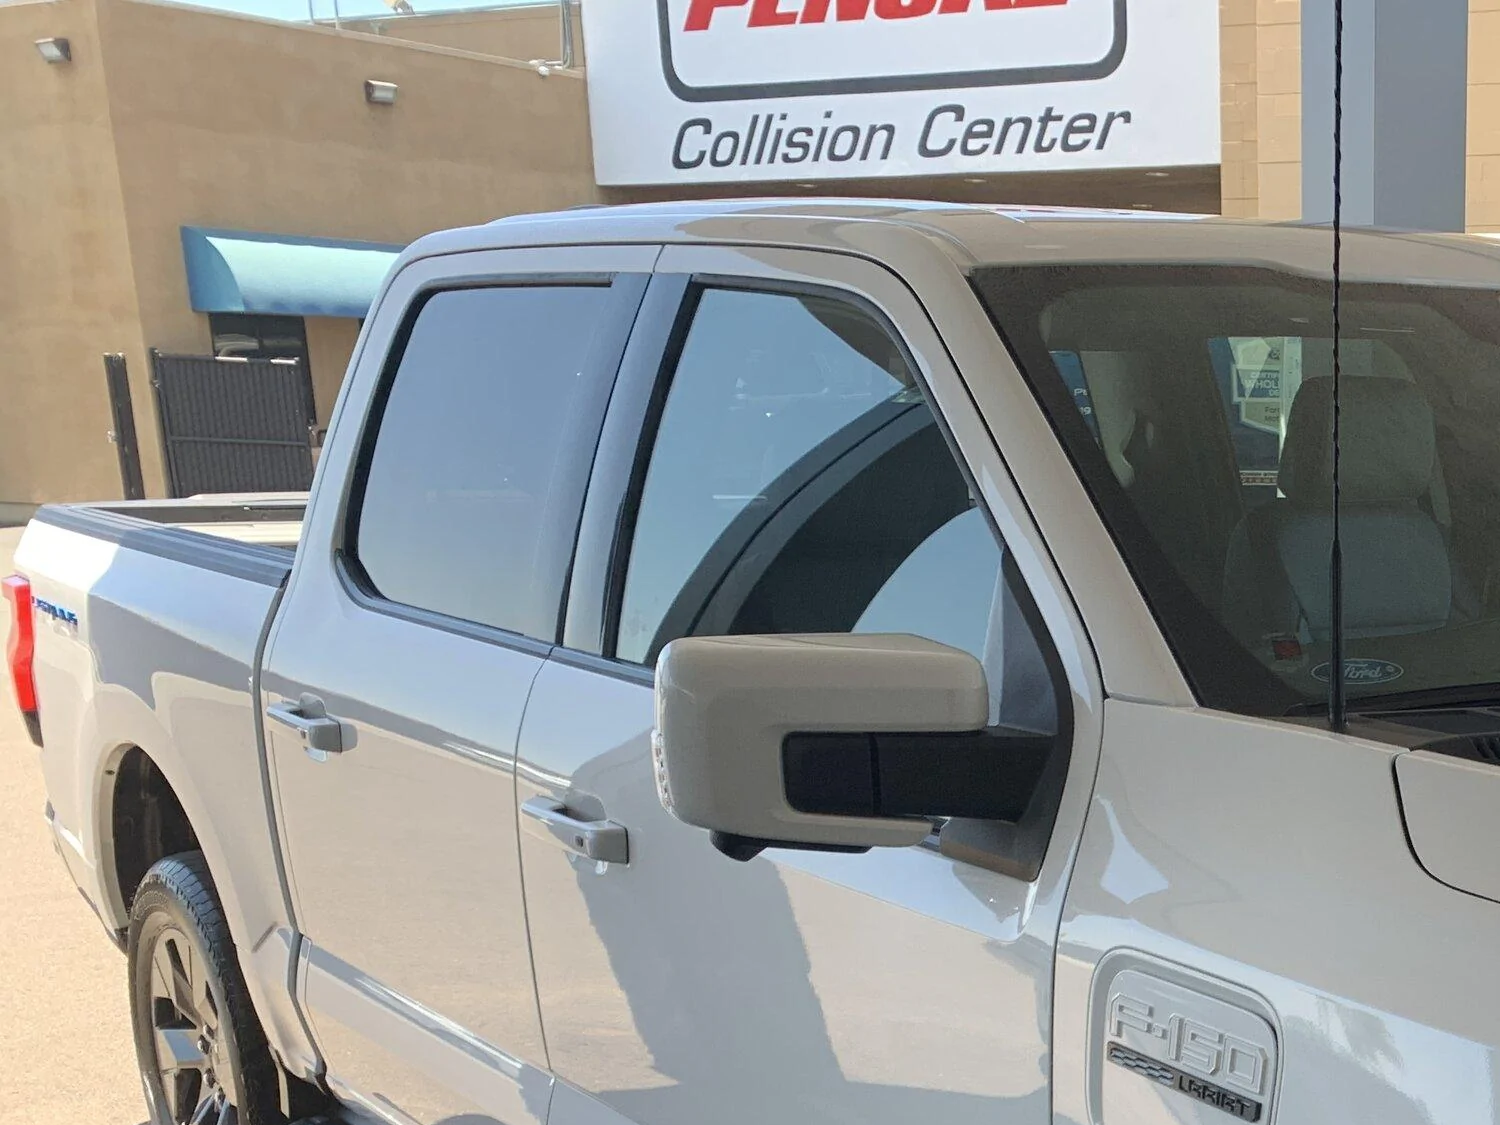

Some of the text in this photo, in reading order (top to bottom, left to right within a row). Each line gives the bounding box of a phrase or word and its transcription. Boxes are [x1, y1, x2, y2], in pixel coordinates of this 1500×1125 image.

[672, 103, 1132, 170] Collision Center
[1110, 992, 1268, 1097] F-150
[1178, 1075, 1250, 1117] LARIAT
